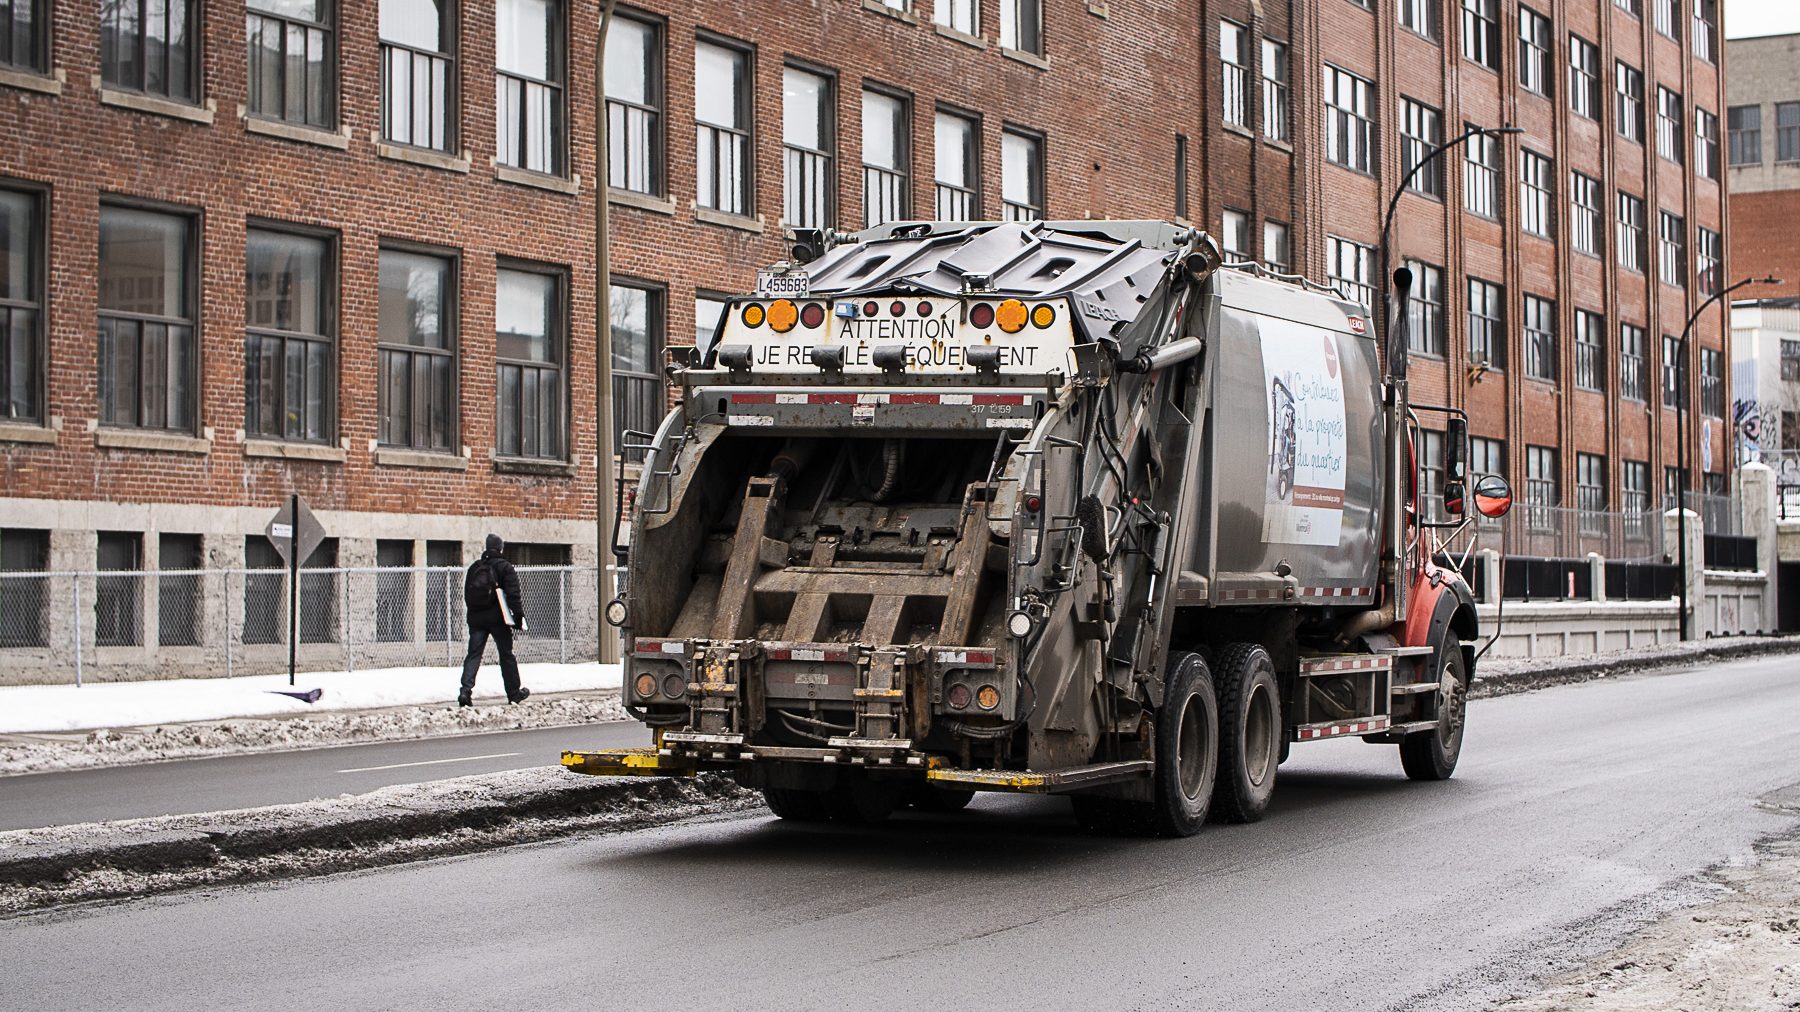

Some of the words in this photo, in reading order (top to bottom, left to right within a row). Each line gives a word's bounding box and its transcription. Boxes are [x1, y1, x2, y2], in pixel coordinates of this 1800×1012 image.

[759, 278, 807, 292] L459683
[840, 319, 955, 339] ATTENTION
[757, 346, 781, 365] JE
[787, 346, 869, 366] RELE
[971, 404, 985, 414] 317
